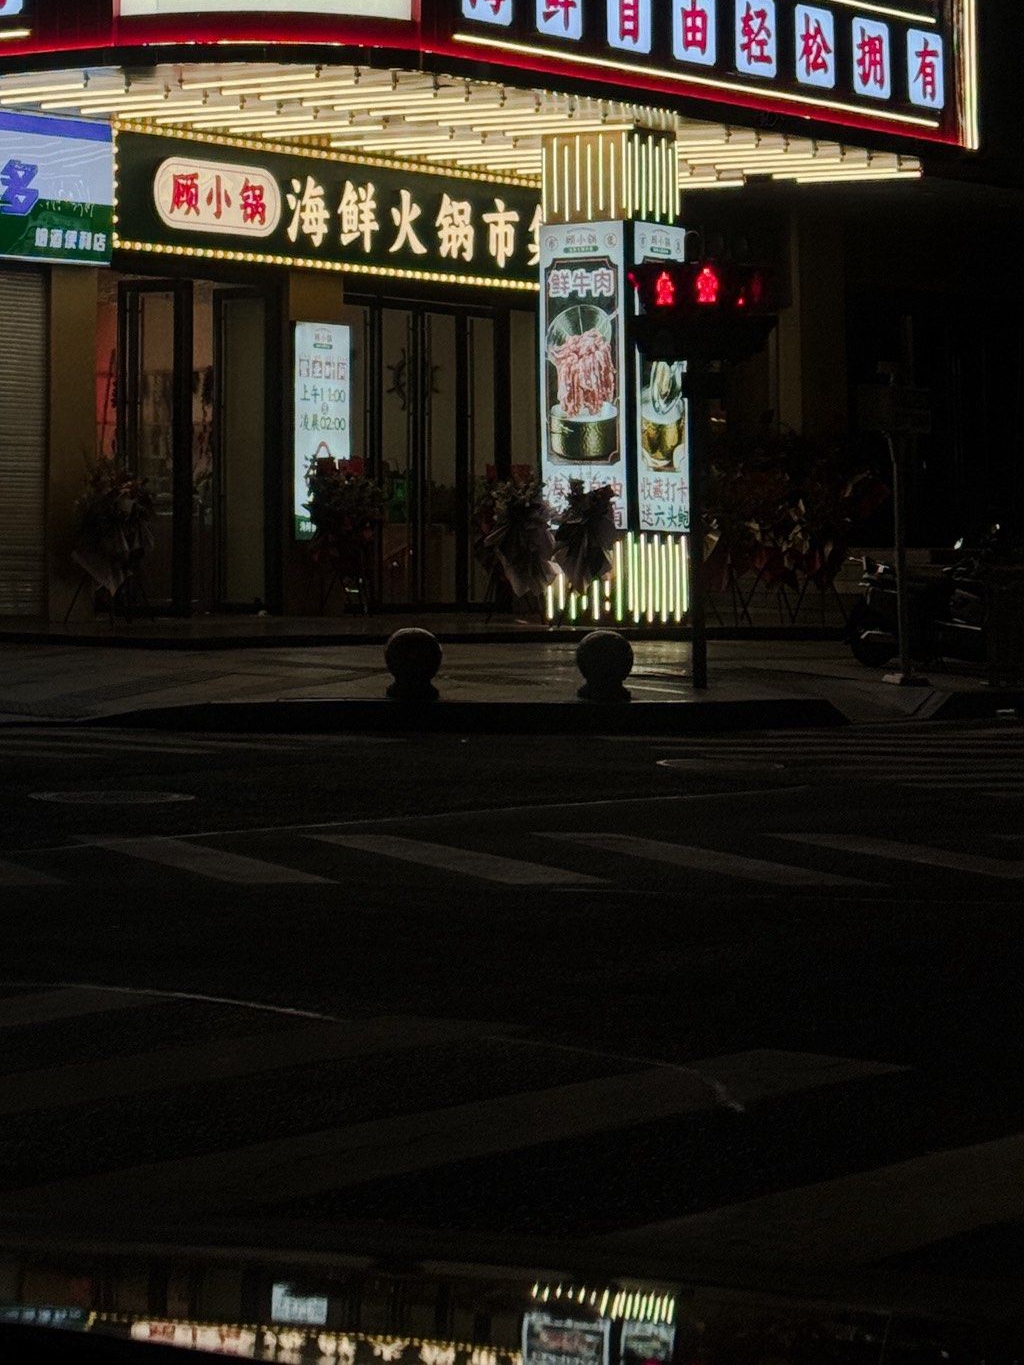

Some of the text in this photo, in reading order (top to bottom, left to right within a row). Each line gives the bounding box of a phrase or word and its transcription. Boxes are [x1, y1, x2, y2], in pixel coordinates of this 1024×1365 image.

[169, 172, 268, 226] 顾小锅
[548, 267, 615, 298] 鲜牛肉
[640, 477, 688, 504] 收藏打卡
[640, 504, 690, 530] 送六头鲍
